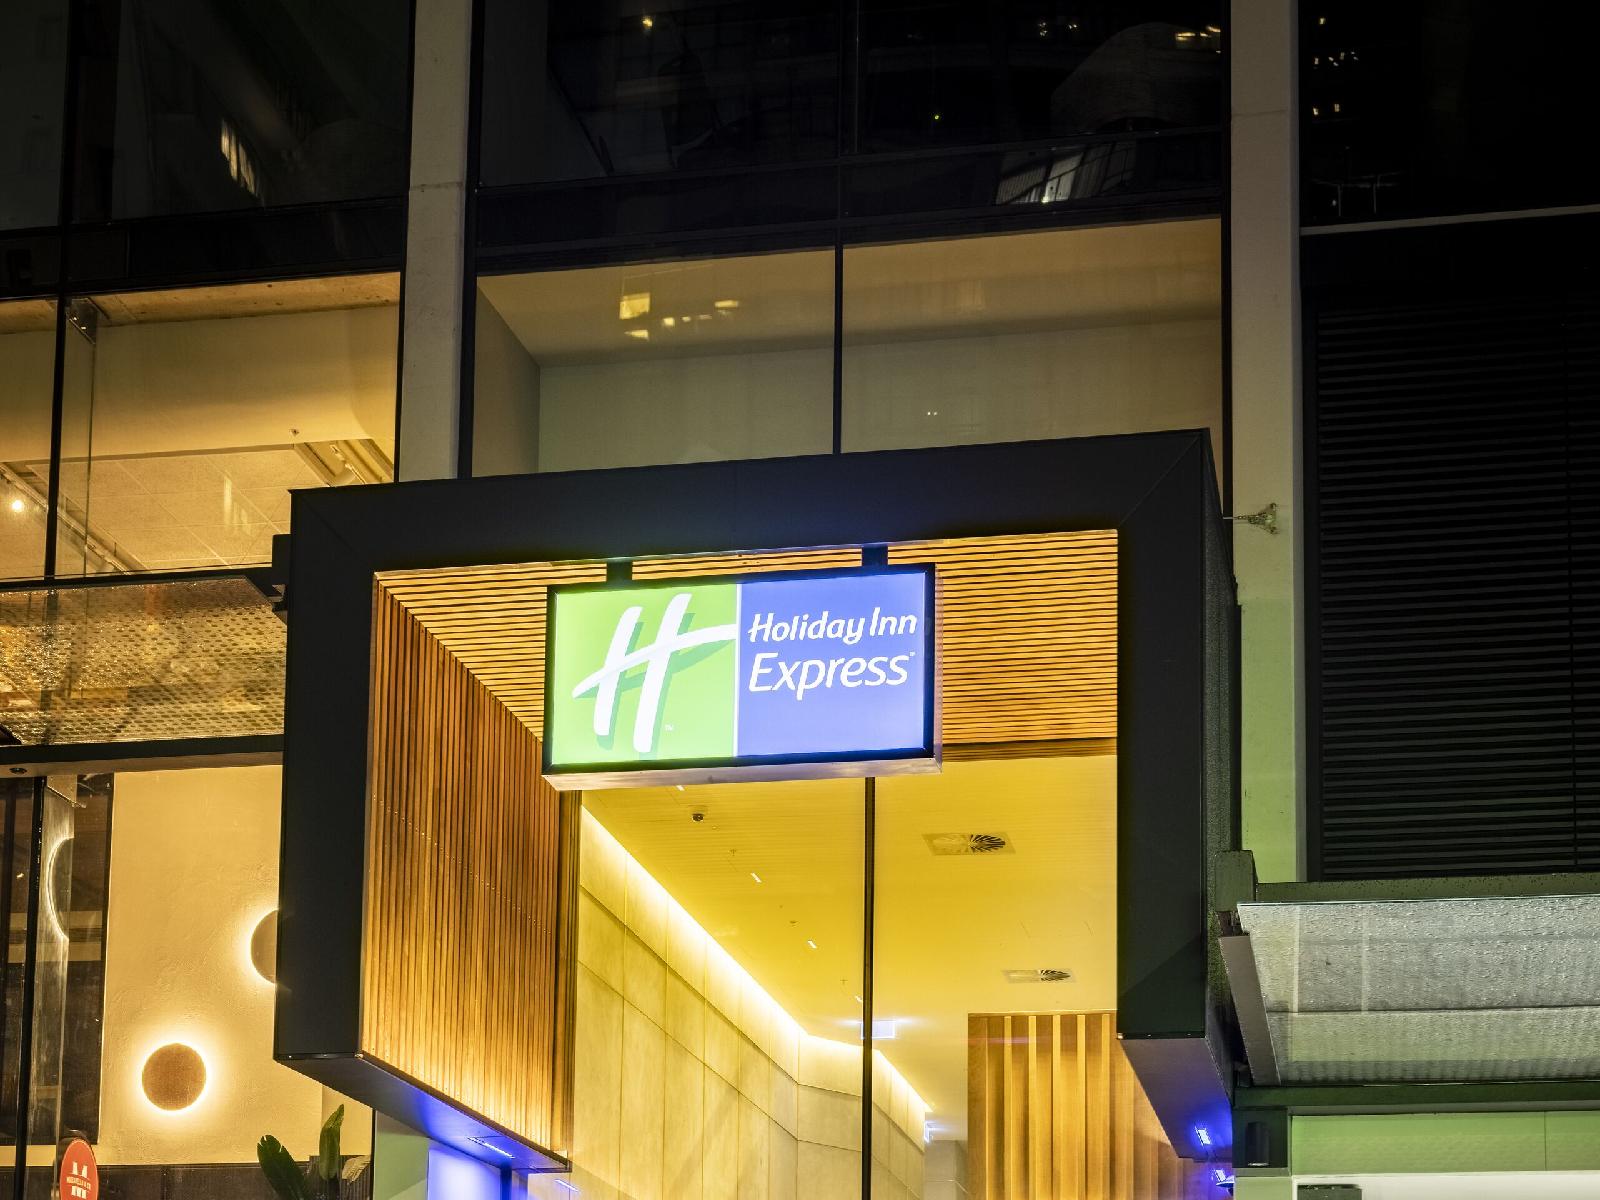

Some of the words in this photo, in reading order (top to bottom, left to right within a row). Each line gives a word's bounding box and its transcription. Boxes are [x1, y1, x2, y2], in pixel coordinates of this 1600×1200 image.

[748, 611, 865, 645] Holiday
[869, 607, 917, 636] Inn
[749, 652, 910, 700] Express
